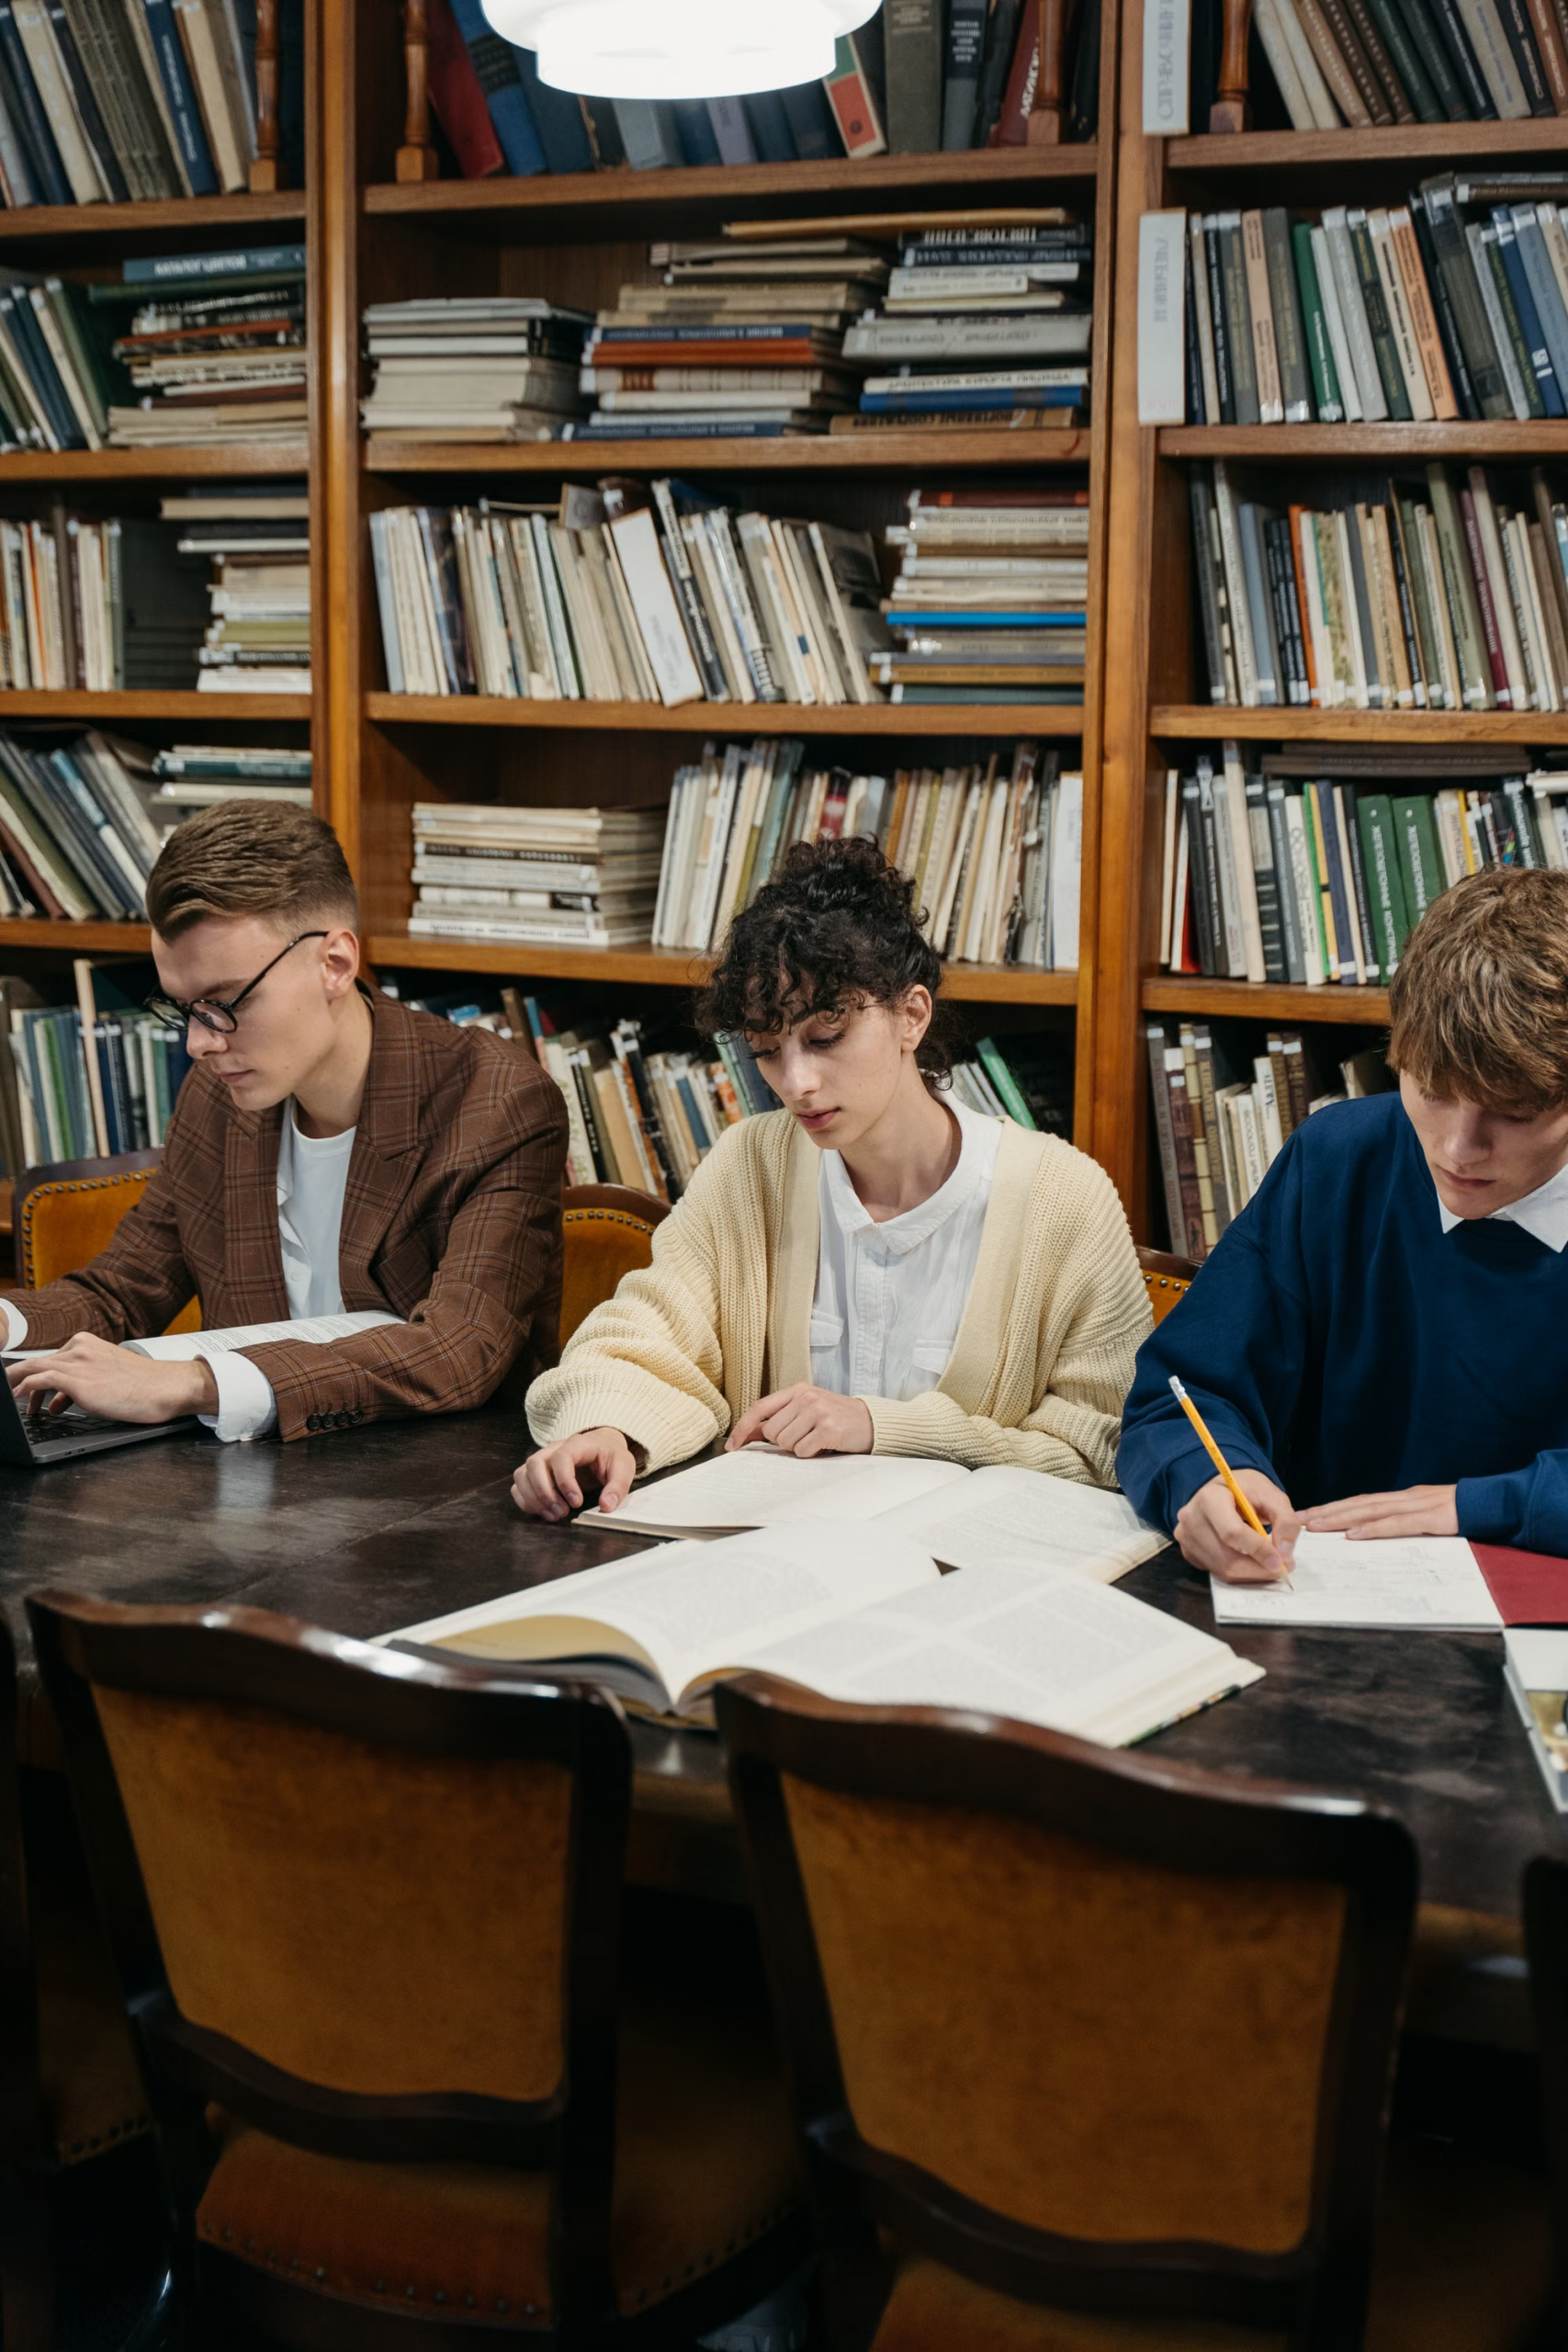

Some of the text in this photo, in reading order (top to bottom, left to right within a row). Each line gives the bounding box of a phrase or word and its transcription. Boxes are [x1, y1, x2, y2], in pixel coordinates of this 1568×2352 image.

[1371, 825, 1398, 965] ЖЕЛЕЗОБЕТОННЫЕ КОНСТРУКЦ
[1407, 825, 1427, 909] ЖЕЛЕЗОБЕТОННЫЕ
